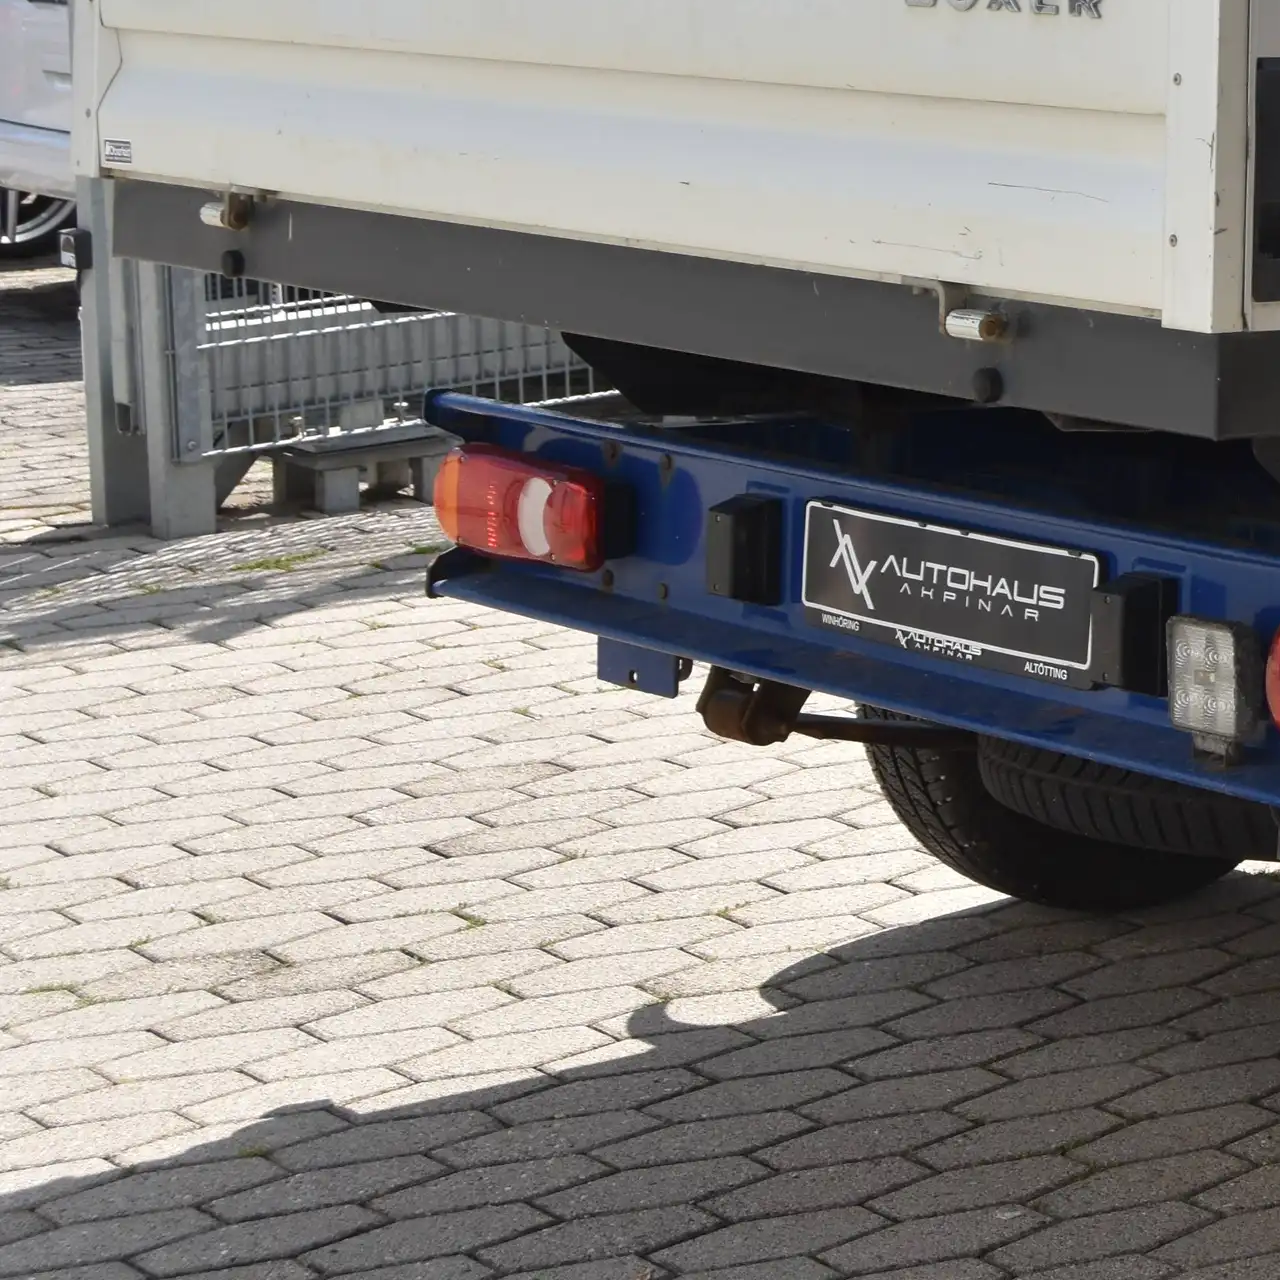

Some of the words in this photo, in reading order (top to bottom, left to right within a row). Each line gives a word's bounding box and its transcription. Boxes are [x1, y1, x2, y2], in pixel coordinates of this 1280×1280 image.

[880, 554, 1066, 610] AUTOHAUS
[900, 582, 1040, 622] AKPINAR
[821, 612, 860, 632] WINHÖRING
[906, 631, 983, 656] AUTOHAUS
[914, 642, 974, 661] AKPINAR
[1023, 660, 1069, 681] ALTÖTTING
